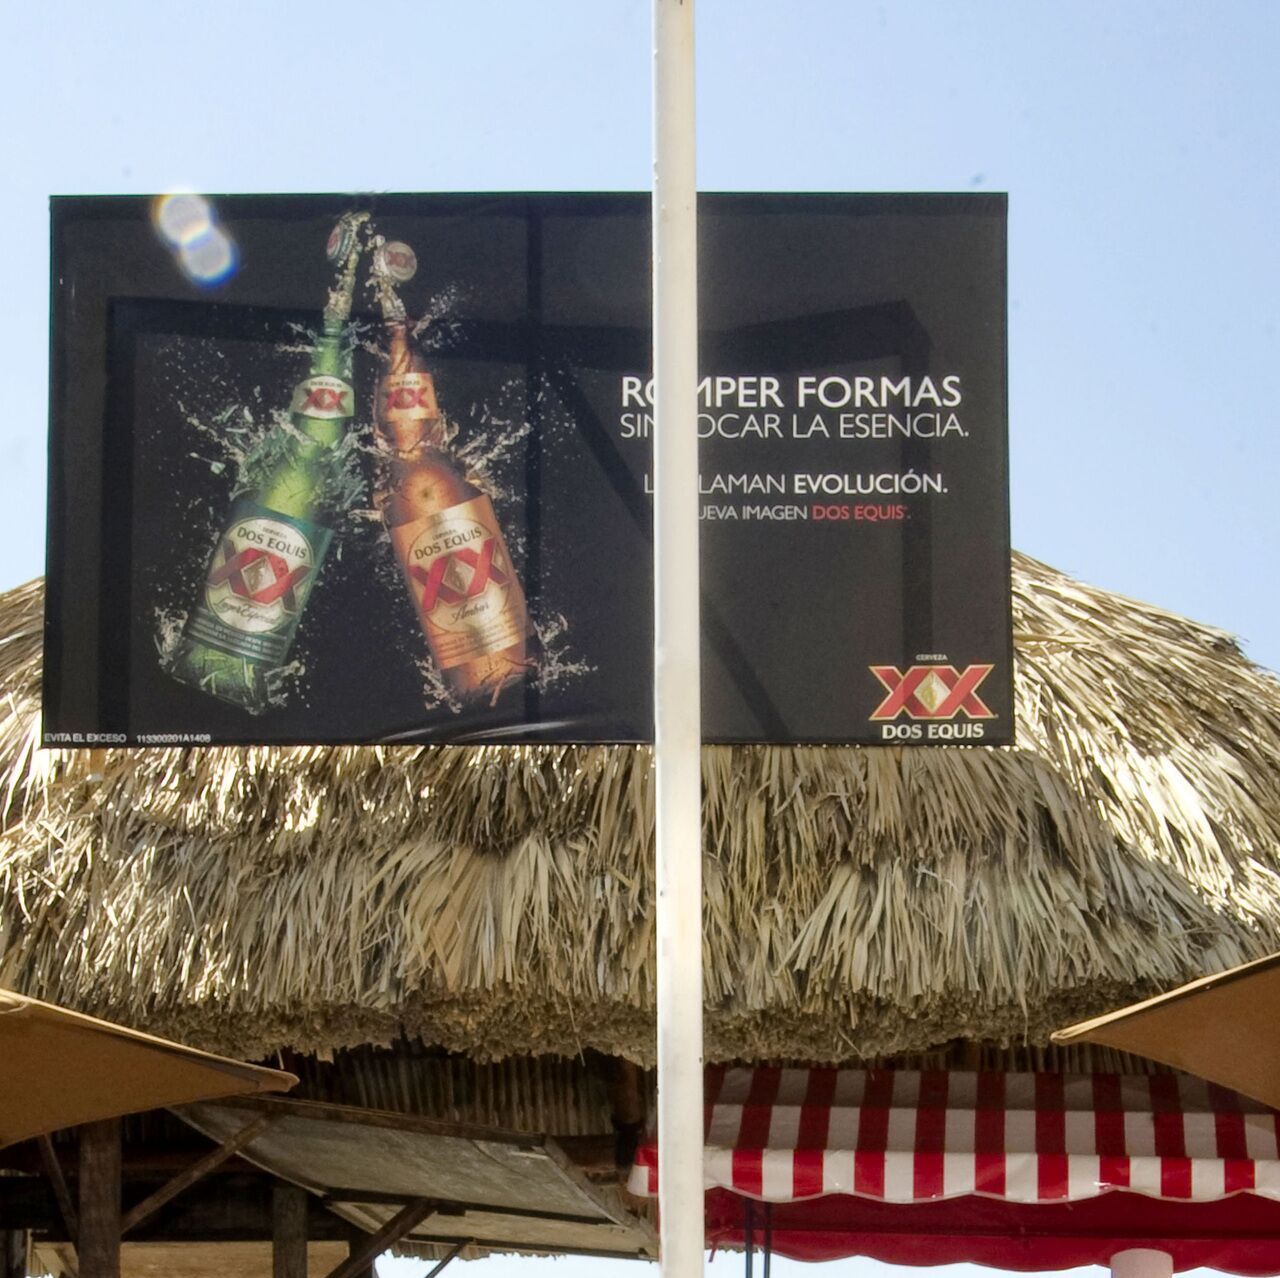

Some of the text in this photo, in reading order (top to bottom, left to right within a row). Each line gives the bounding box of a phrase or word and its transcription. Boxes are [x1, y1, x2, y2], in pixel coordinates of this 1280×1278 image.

[797, 376, 962, 408] FORMAS
[696, 413, 784, 438] OCAR
[792, 413, 830, 438] LA
[839, 413, 969, 439] ESENCIA.
[698, 473, 785, 494] LAMAN
[793, 467, 948, 494] EVOLUCIÓN.
[742, 505, 808, 521] IMAGEN
[812, 505, 850, 520] DOS
[236, 526, 308, 560] DOS EQUIS
[414, 526, 483, 561] DOS EQUIS
[868, 664, 995, 721] XX
[44, 733, 72, 743] EVITA
[73, 733, 85, 743] EL
[86, 733, 127, 744] EXCESO
[882, 723, 985, 739] DOS EQUIS
